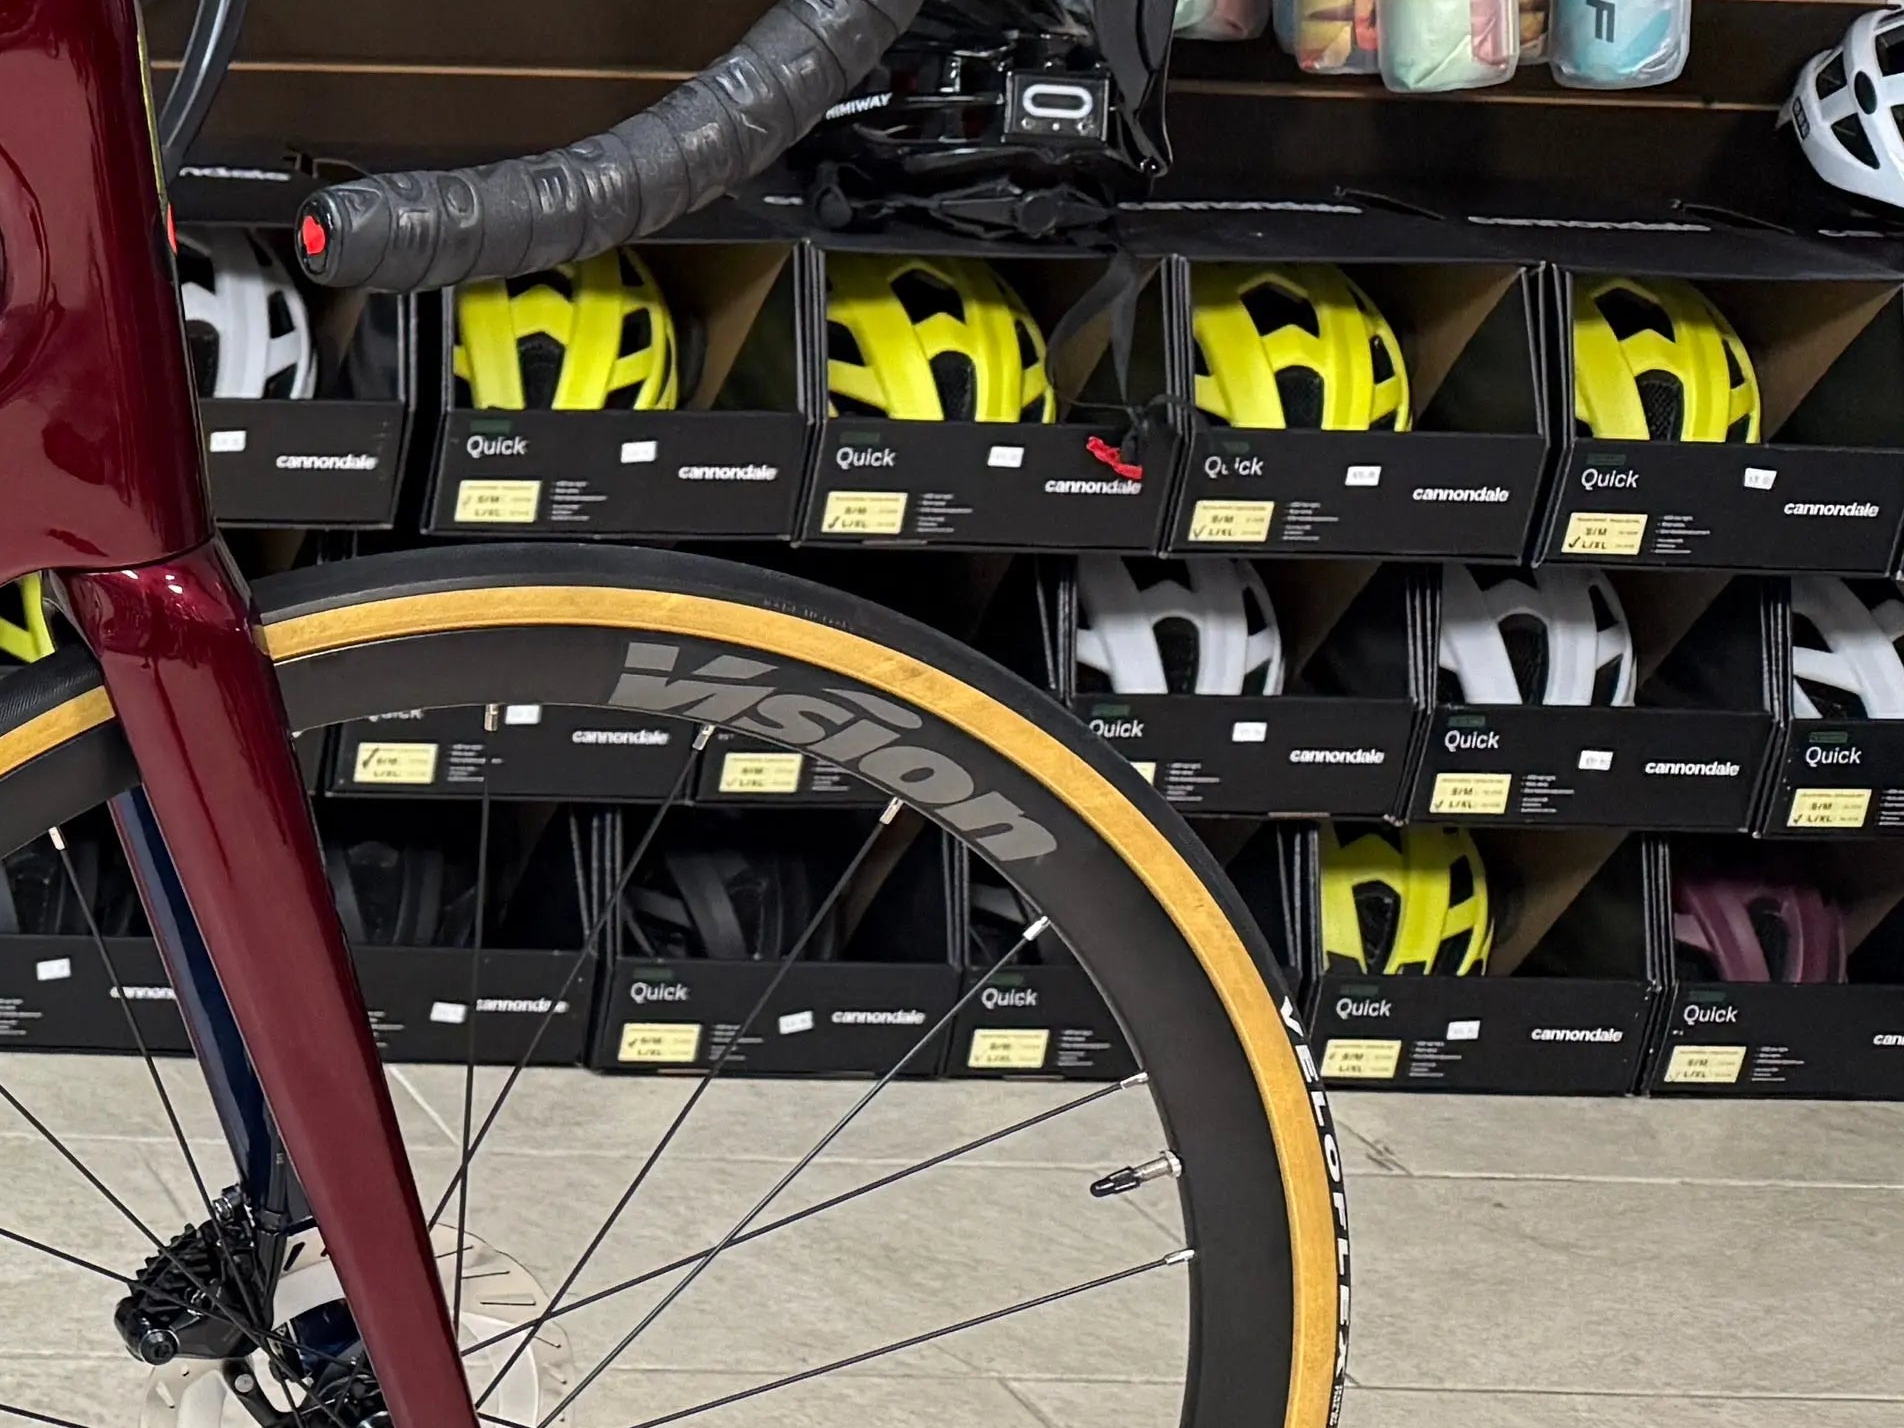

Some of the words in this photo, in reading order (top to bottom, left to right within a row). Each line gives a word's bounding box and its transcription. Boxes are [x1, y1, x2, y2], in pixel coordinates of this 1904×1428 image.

[467, 435, 527, 458] Quick
[276, 454, 379, 471] cannondale
[836, 447, 896, 470] Quick
[678, 465, 777, 483] cannondale
[1581, 468, 1639, 490] Quick
[1044, 477, 1142, 496] cannondale
[1412, 485, 1509, 504] cannondale
[1783, 500, 1879, 519] cannondale
[572, 728, 671, 745] cannondale
[1088, 717, 1144, 740] Quick
[609, 640, 1058, 863] Vision
[1444, 730, 1500, 752] Quick
[1289, 748, 1385, 765] cannondale
[1804, 745, 1862, 767] Quick
[1644, 759, 1740, 776] cannondale
[629, 980, 688, 1002] Quick
[981, 986, 1038, 1008] Quick
[831, 1010, 925, 1025] cannondale
[1336, 997, 1392, 1019] Quick
[1683, 1003, 1739, 1026] Quick
[1531, 1027, 1623, 1043] cannondale
[1874, 1031, 1904, 1046] can
[1278, 994, 1353, 1378] VELOFLEX
